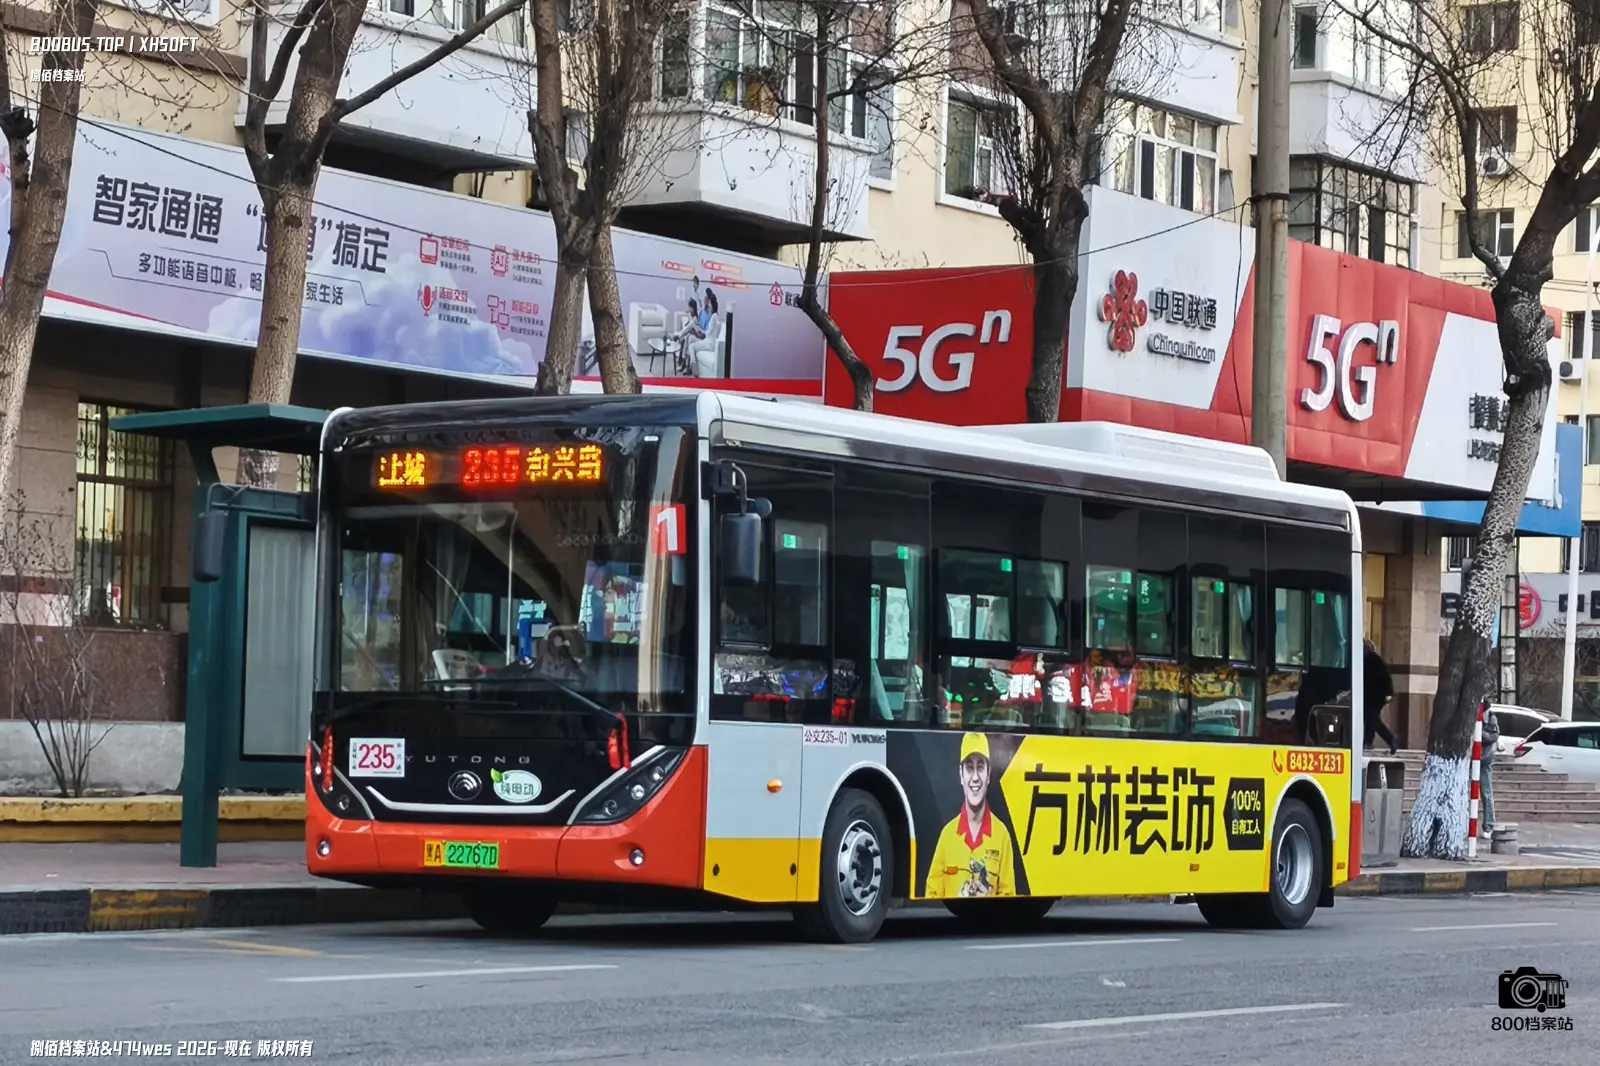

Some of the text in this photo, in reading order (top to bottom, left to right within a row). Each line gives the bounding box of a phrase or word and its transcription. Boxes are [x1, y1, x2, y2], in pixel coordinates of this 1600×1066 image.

[93, 175, 223, 244] 智家通通
[1152, 288, 1217, 330] 中国联通
[657, 507, 678, 551] 1
[358, 743, 395, 769] 235
[501, 782, 534, 796] 纯电动
[1231, 789, 1261, 812] 100%
[1023, 763, 1215, 855] 方林装饰
[1231, 819, 1261, 835] 自有工人
